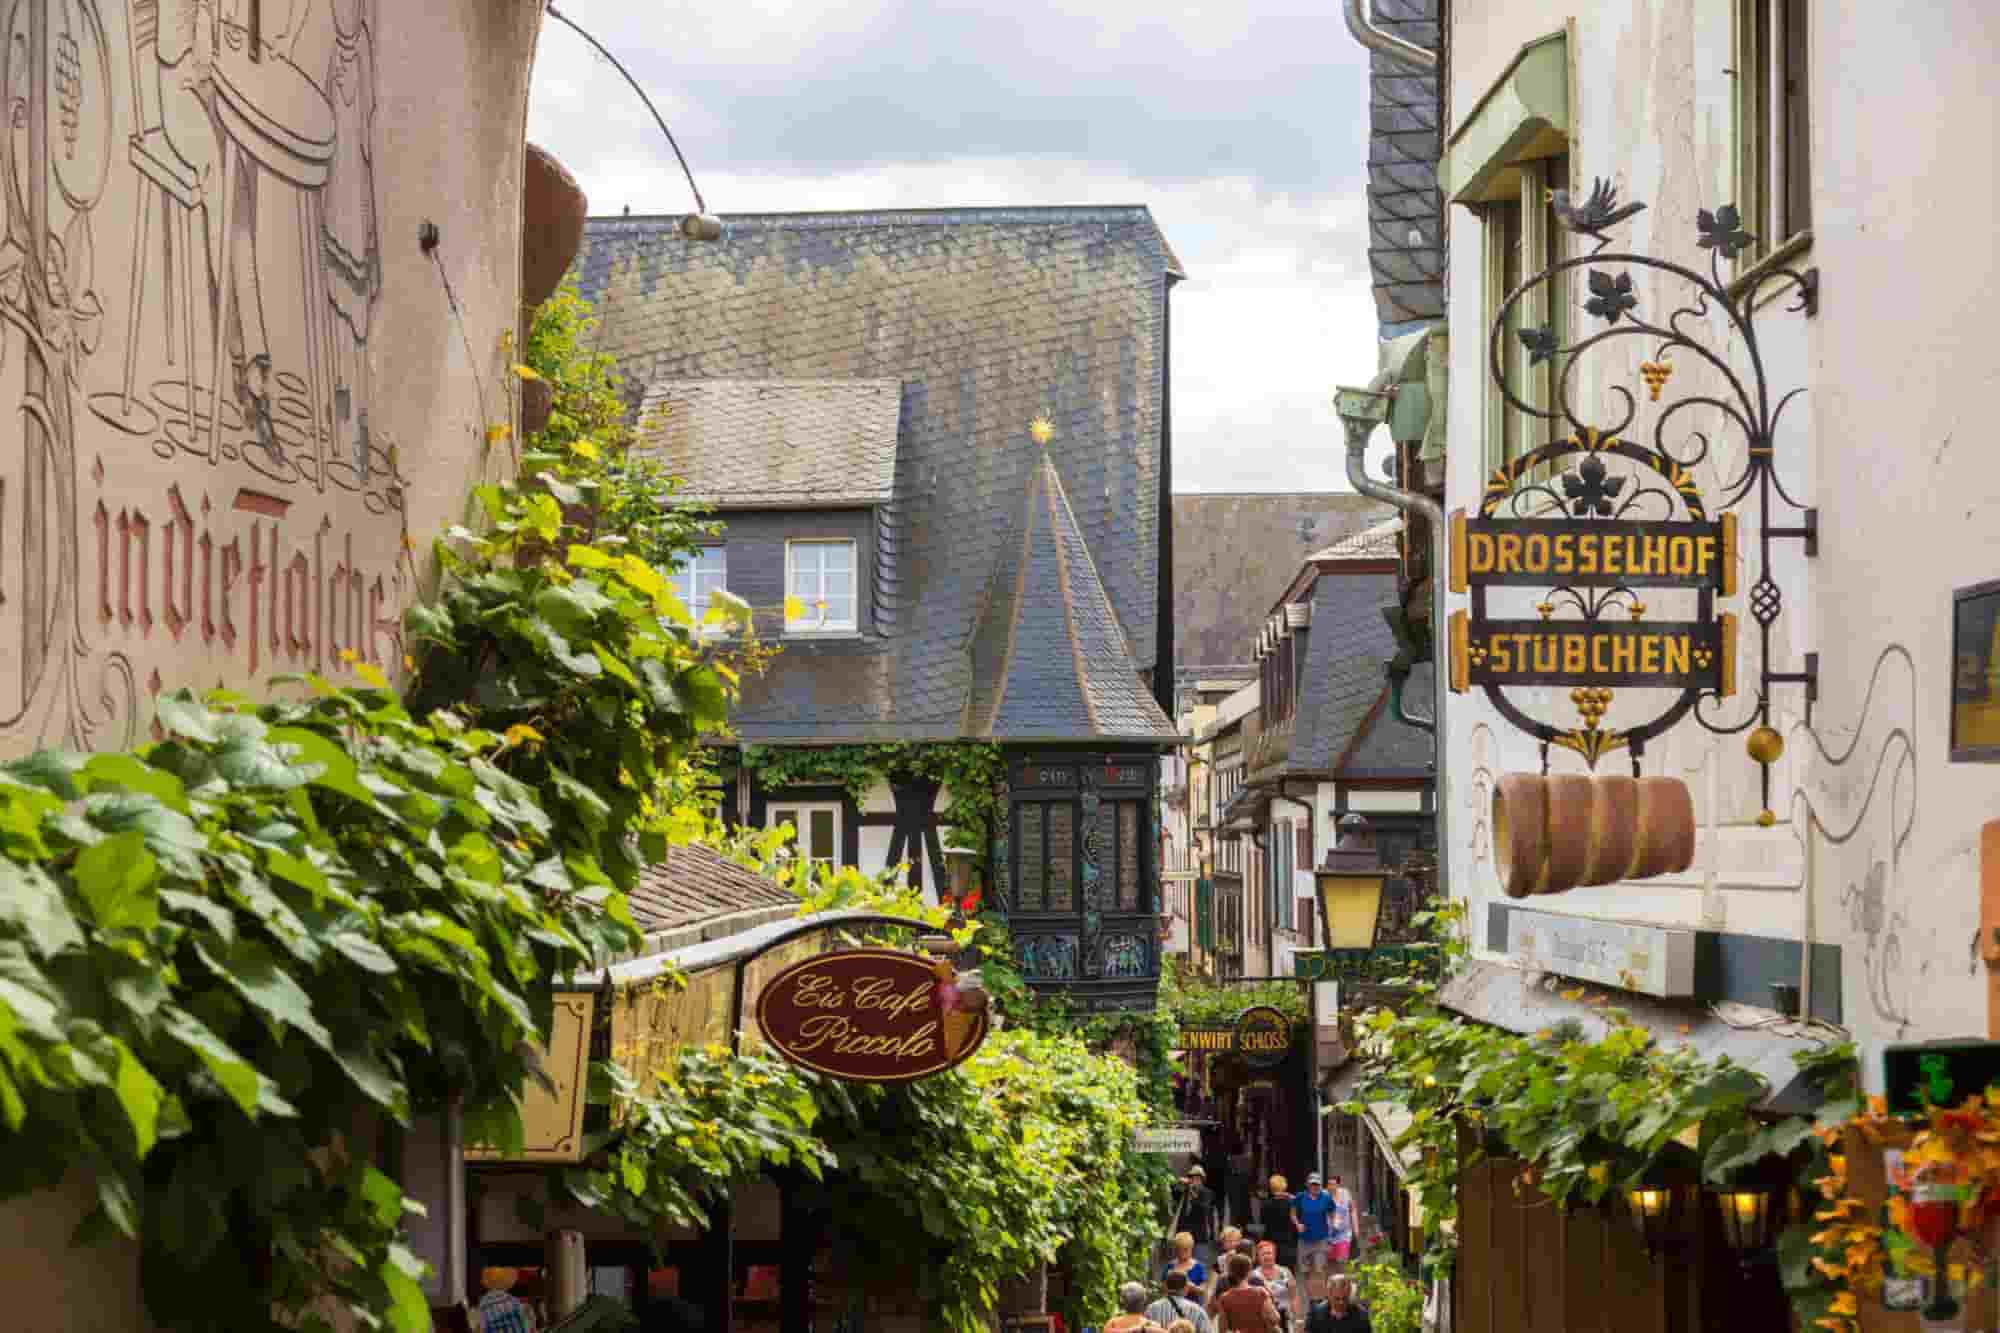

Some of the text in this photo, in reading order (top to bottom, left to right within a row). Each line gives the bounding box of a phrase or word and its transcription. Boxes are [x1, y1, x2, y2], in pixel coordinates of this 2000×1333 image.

[1469, 533, 1716, 576] DROSSELHOF
[1490, 633, 1690, 674] STÜBCHEN
[792, 974, 846, 1008] Eis
[788, 1014, 938, 1063] Piccolo
[1178, 1031, 1232, 1049] ENWIRT
